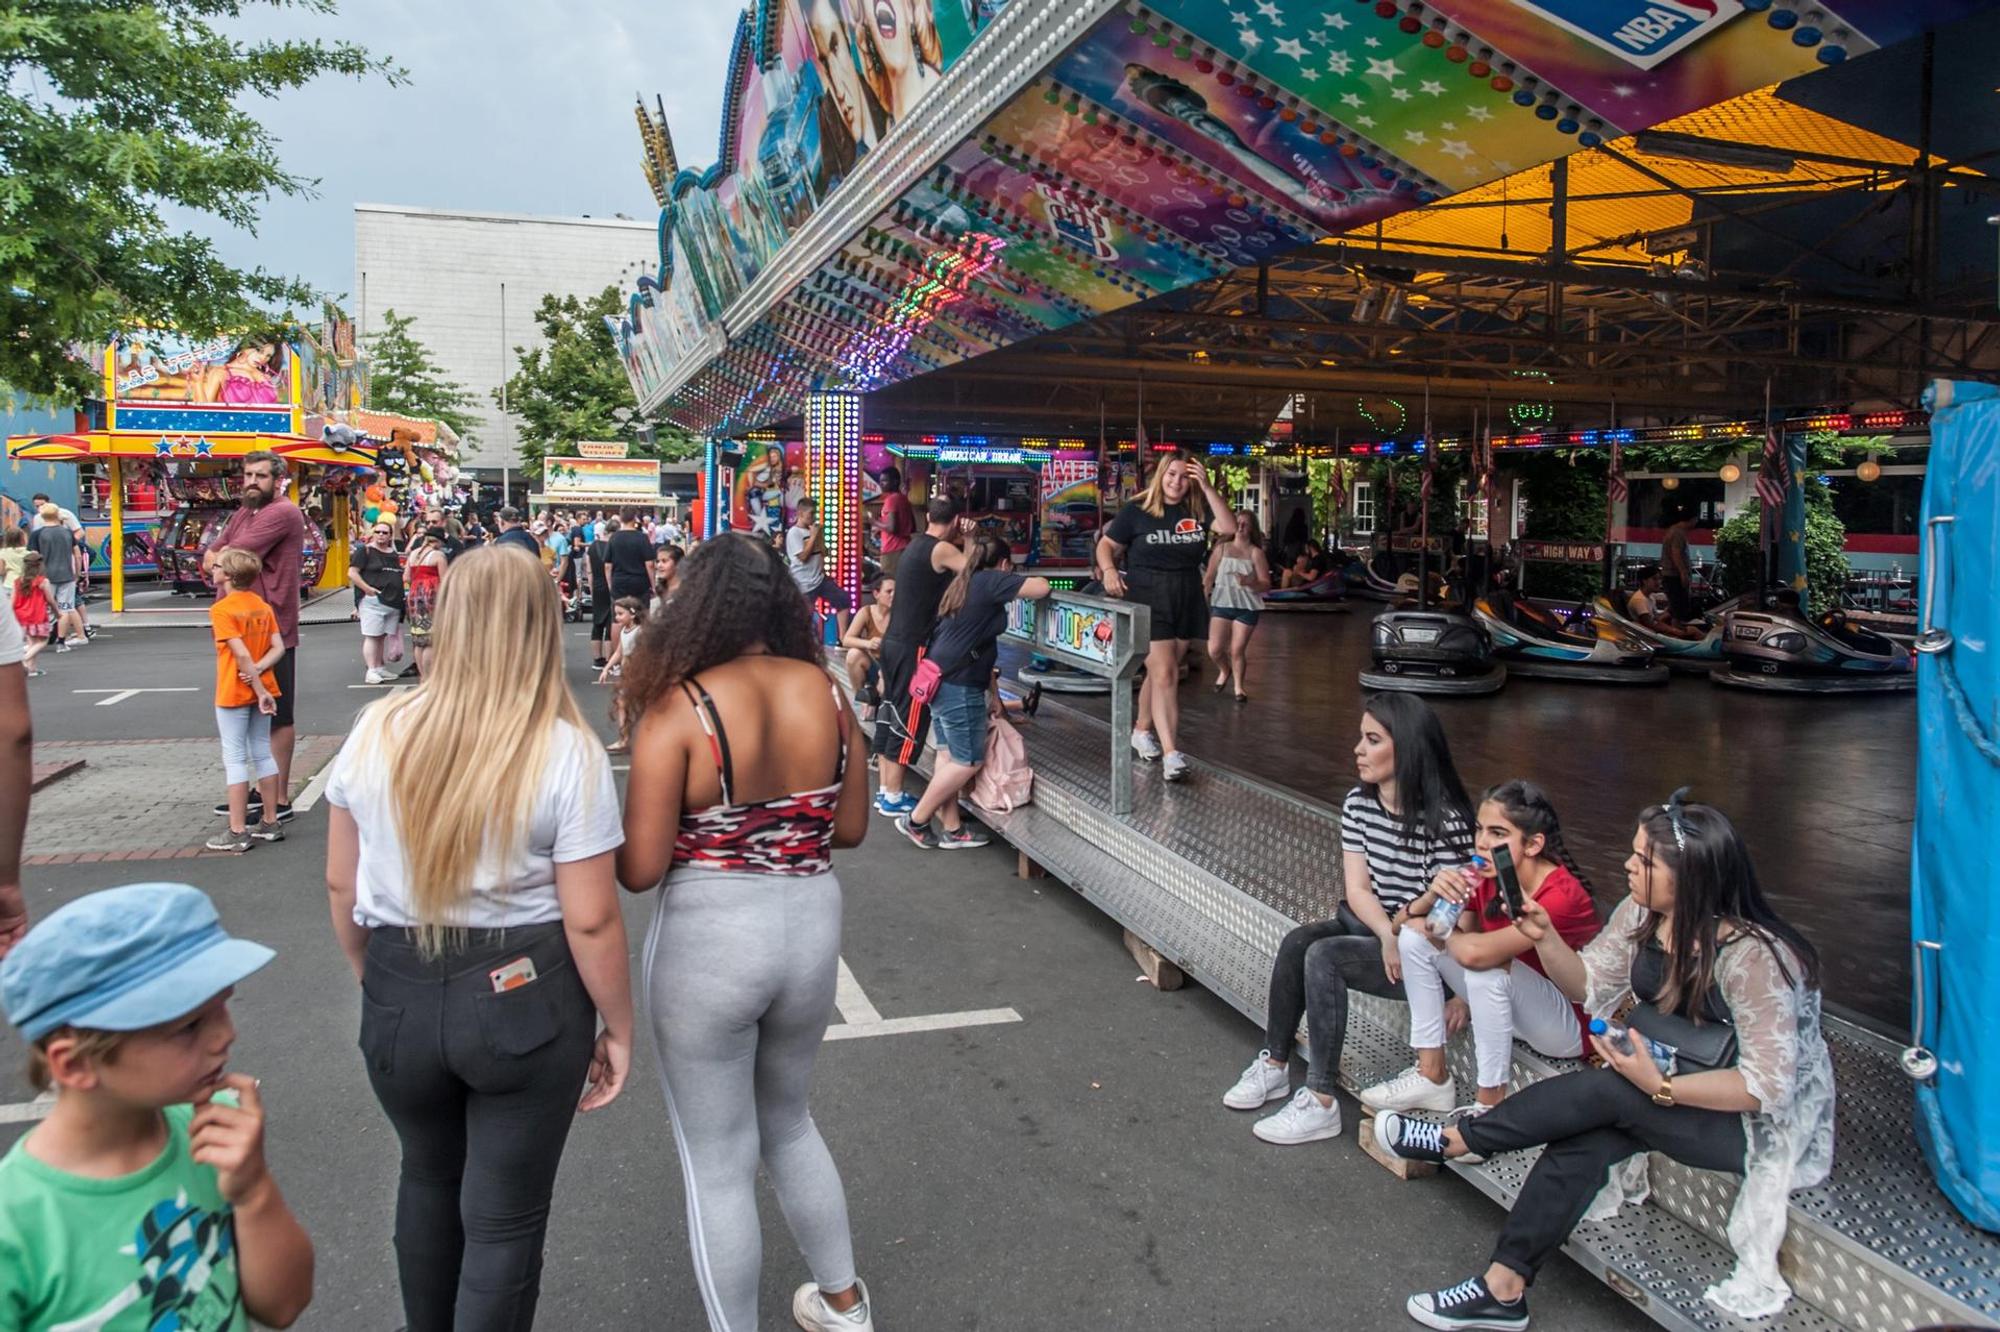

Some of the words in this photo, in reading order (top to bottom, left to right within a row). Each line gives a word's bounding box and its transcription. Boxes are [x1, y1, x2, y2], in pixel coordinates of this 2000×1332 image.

[1612, 7, 1688, 51] NBA
[940, 450, 987, 462] AMERICAN
[991, 452, 1022, 463] DREAM
[1543, 544, 1564, 558] HIGH
[1568, 545, 1591, 560] WAY
